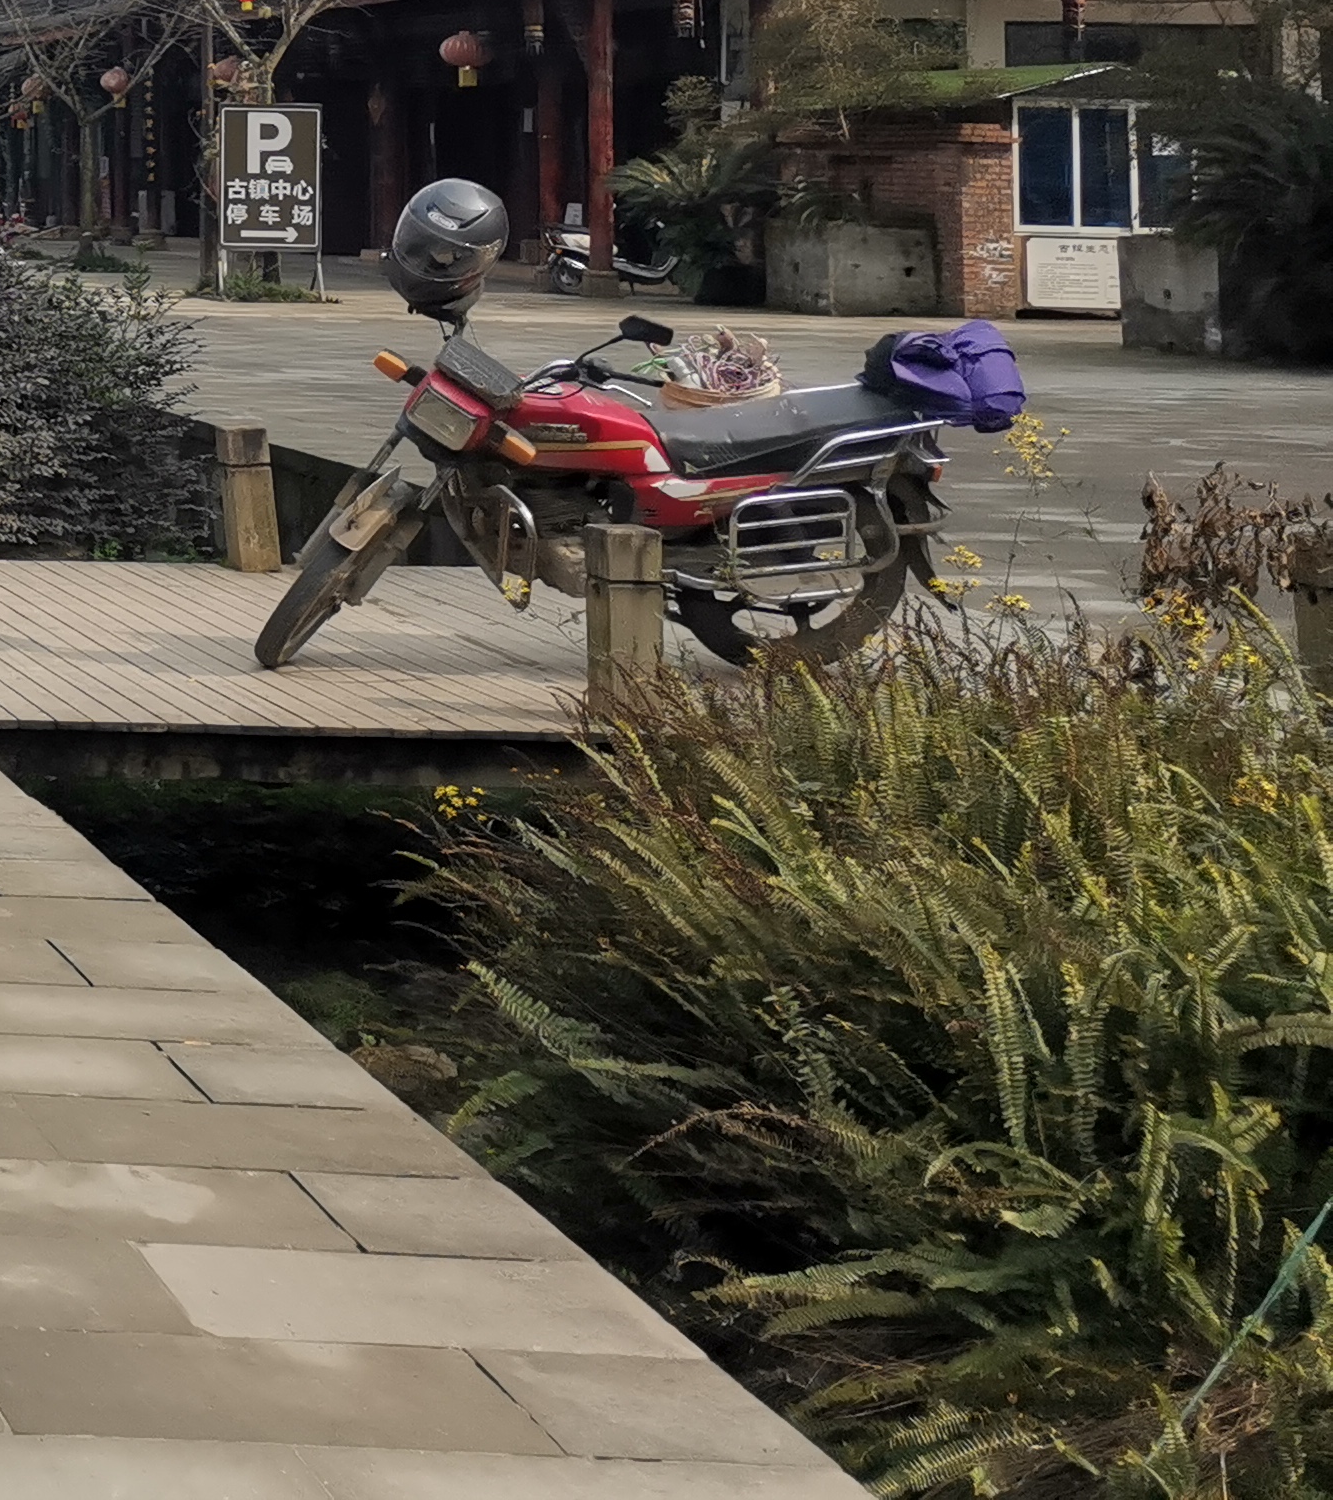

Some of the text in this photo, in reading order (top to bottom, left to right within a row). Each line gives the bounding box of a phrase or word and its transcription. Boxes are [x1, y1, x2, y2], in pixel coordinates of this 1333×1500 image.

[246, 112, 293, 174] P
[226, 178, 314, 201] 古镇中心
[226, 203, 314, 226] 停车场
